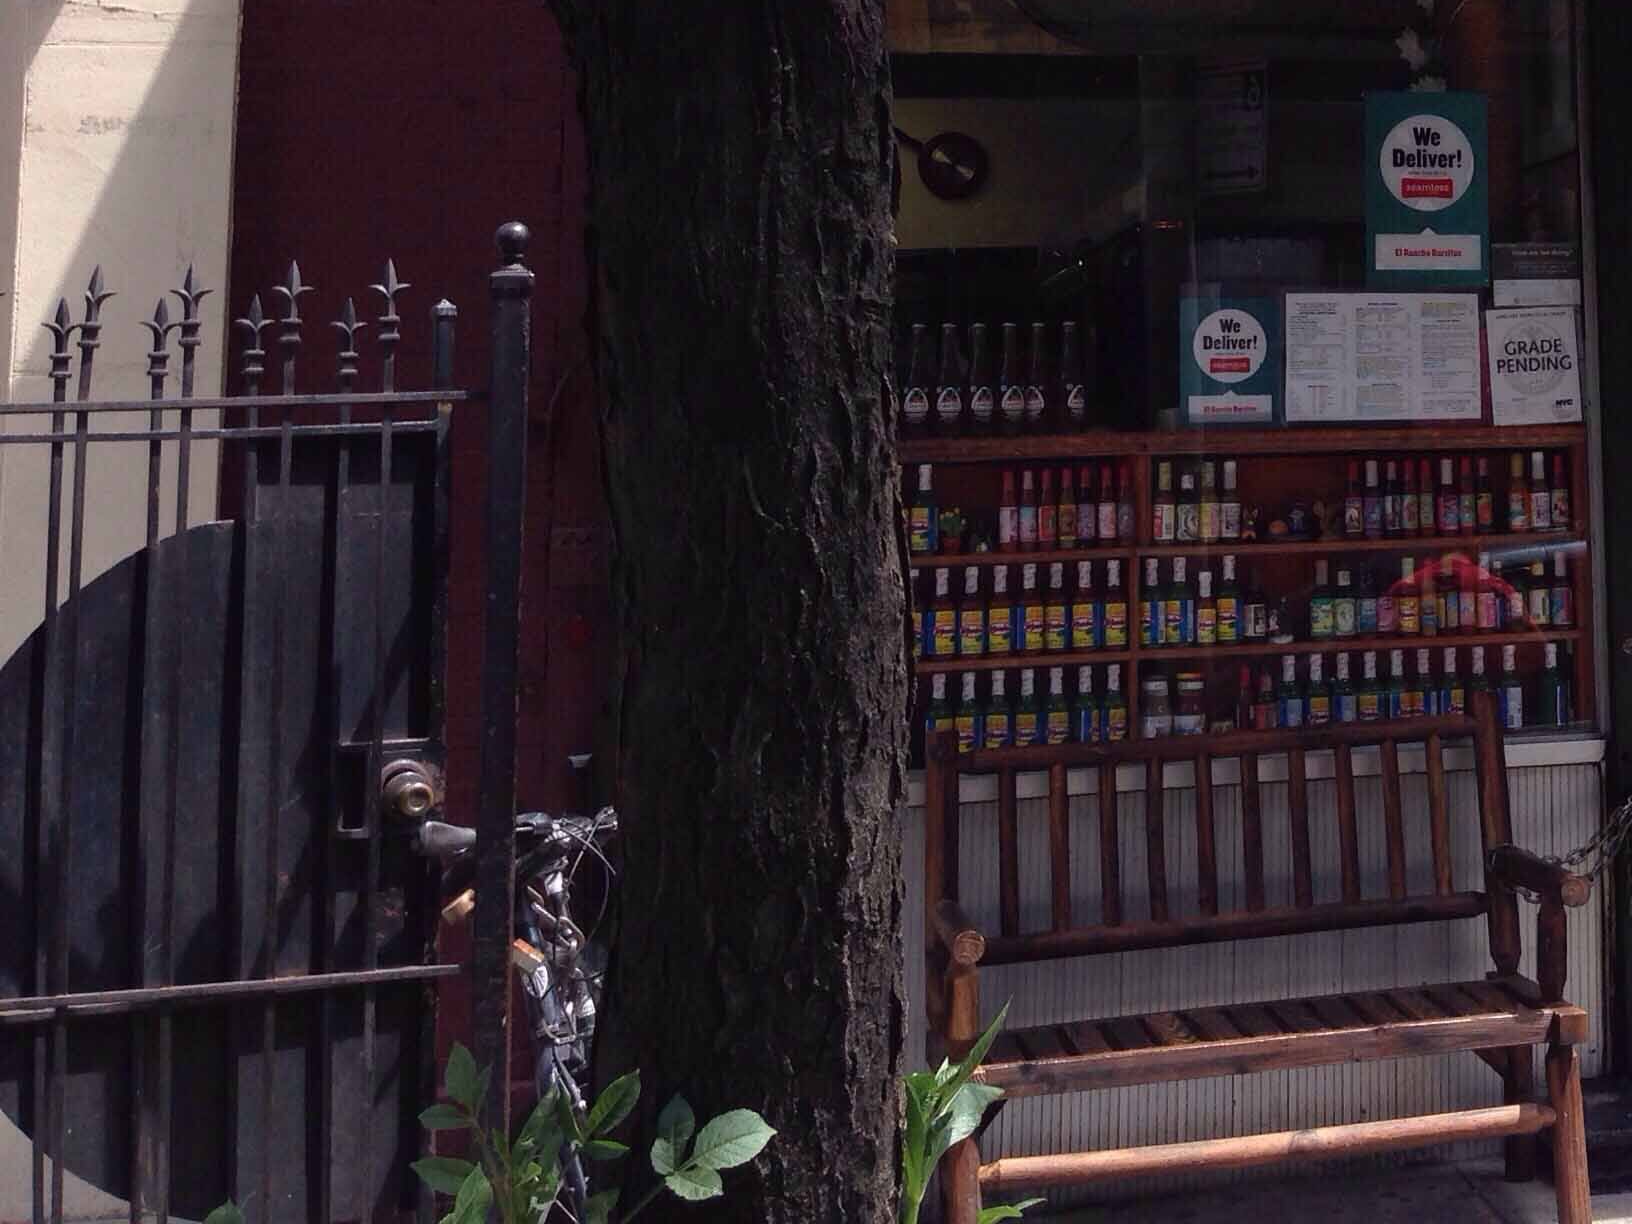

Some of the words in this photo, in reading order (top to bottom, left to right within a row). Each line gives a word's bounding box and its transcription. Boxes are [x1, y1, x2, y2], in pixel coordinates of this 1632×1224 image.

[1412, 127, 1441, 146] We
[1392, 148, 1462, 168] Deliver!
[1219, 318, 1241, 333] We
[1203, 335, 1258, 350] Deliver!
[1504, 338, 1562, 355] GRADE
[1496, 355, 1572, 374] PENDING
[1555, 399, 1574, 407] NYC
